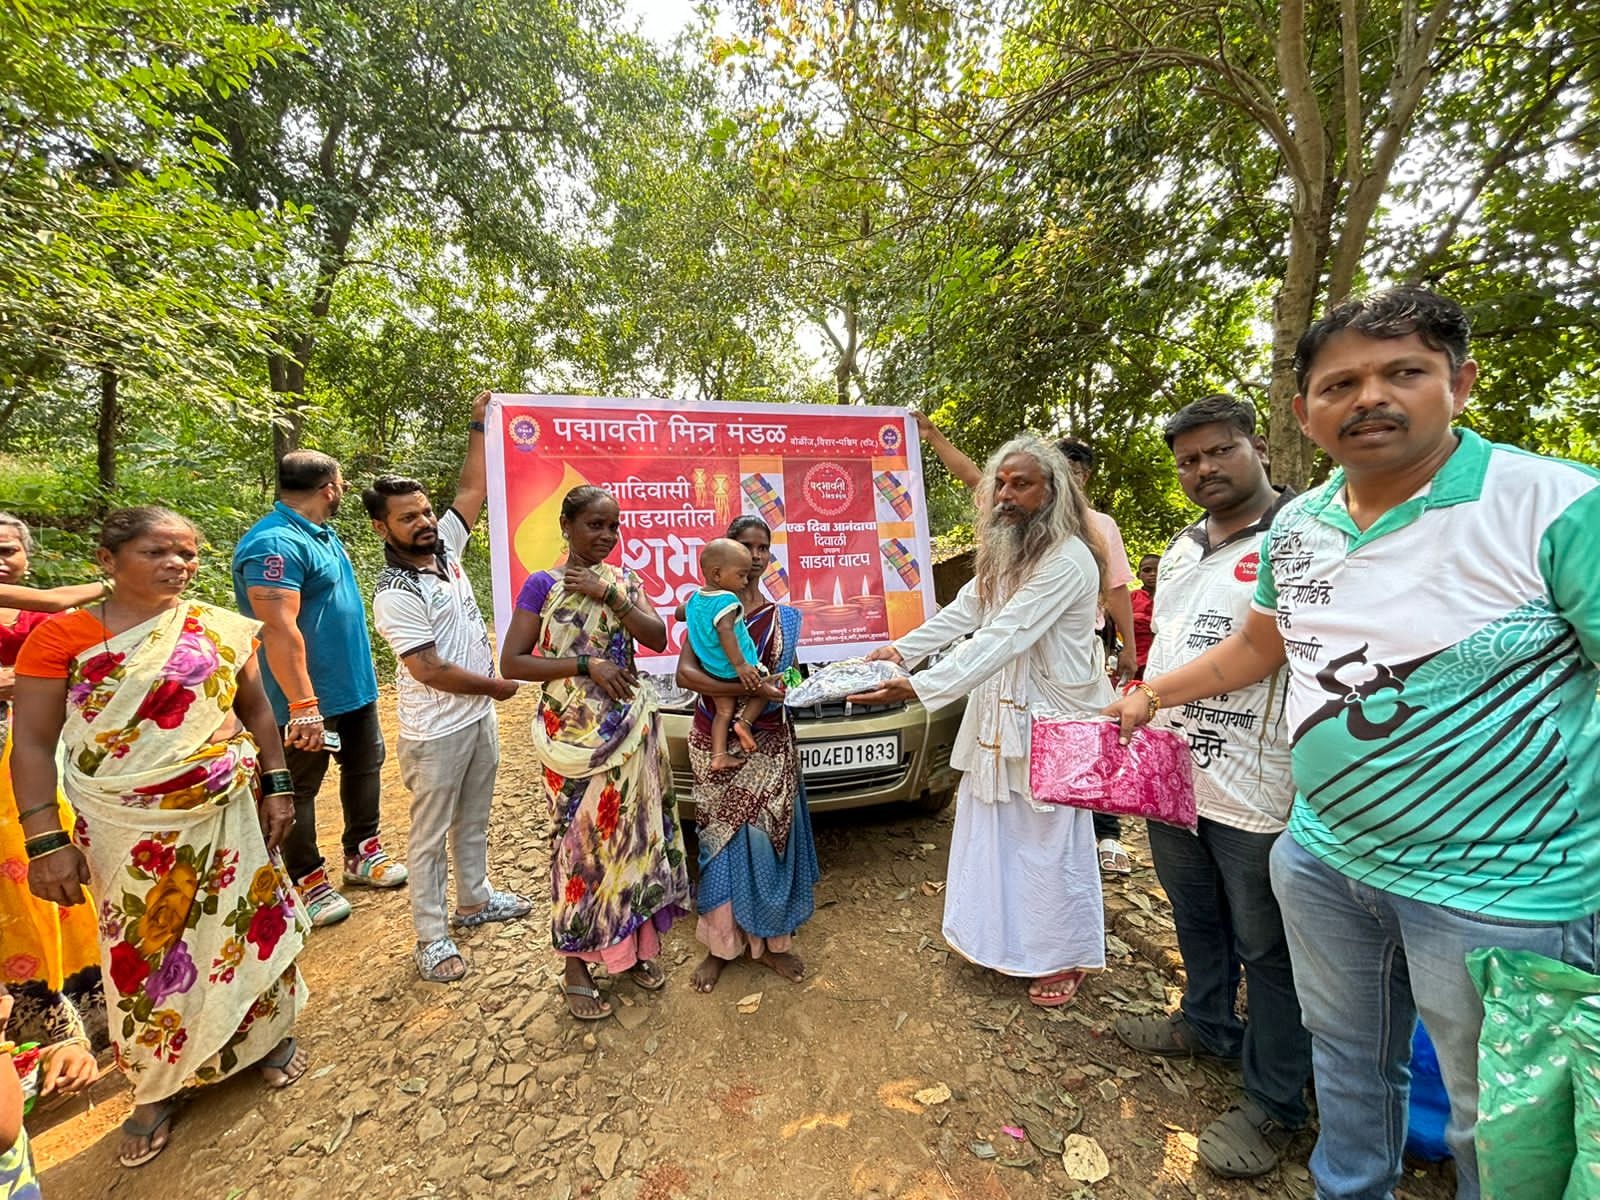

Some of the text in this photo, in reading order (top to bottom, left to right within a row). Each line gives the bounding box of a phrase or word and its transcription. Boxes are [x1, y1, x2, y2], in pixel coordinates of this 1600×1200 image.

[553, 413, 658, 443] पद्मावती
[668, 414, 717, 444] मित्र
[727, 417, 787, 444] मंडळ
[601, 475, 691, 500] आदिवासी
[786, 523, 805, 532] एक
[807, 519, 830, 532] दिवा
[814, 533, 846, 546] दिवाळी
[264, 556, 284, 581] 3
[799, 553, 870, 568] साडया वाटप
[801, 742, 895, 769] H04ED1833
